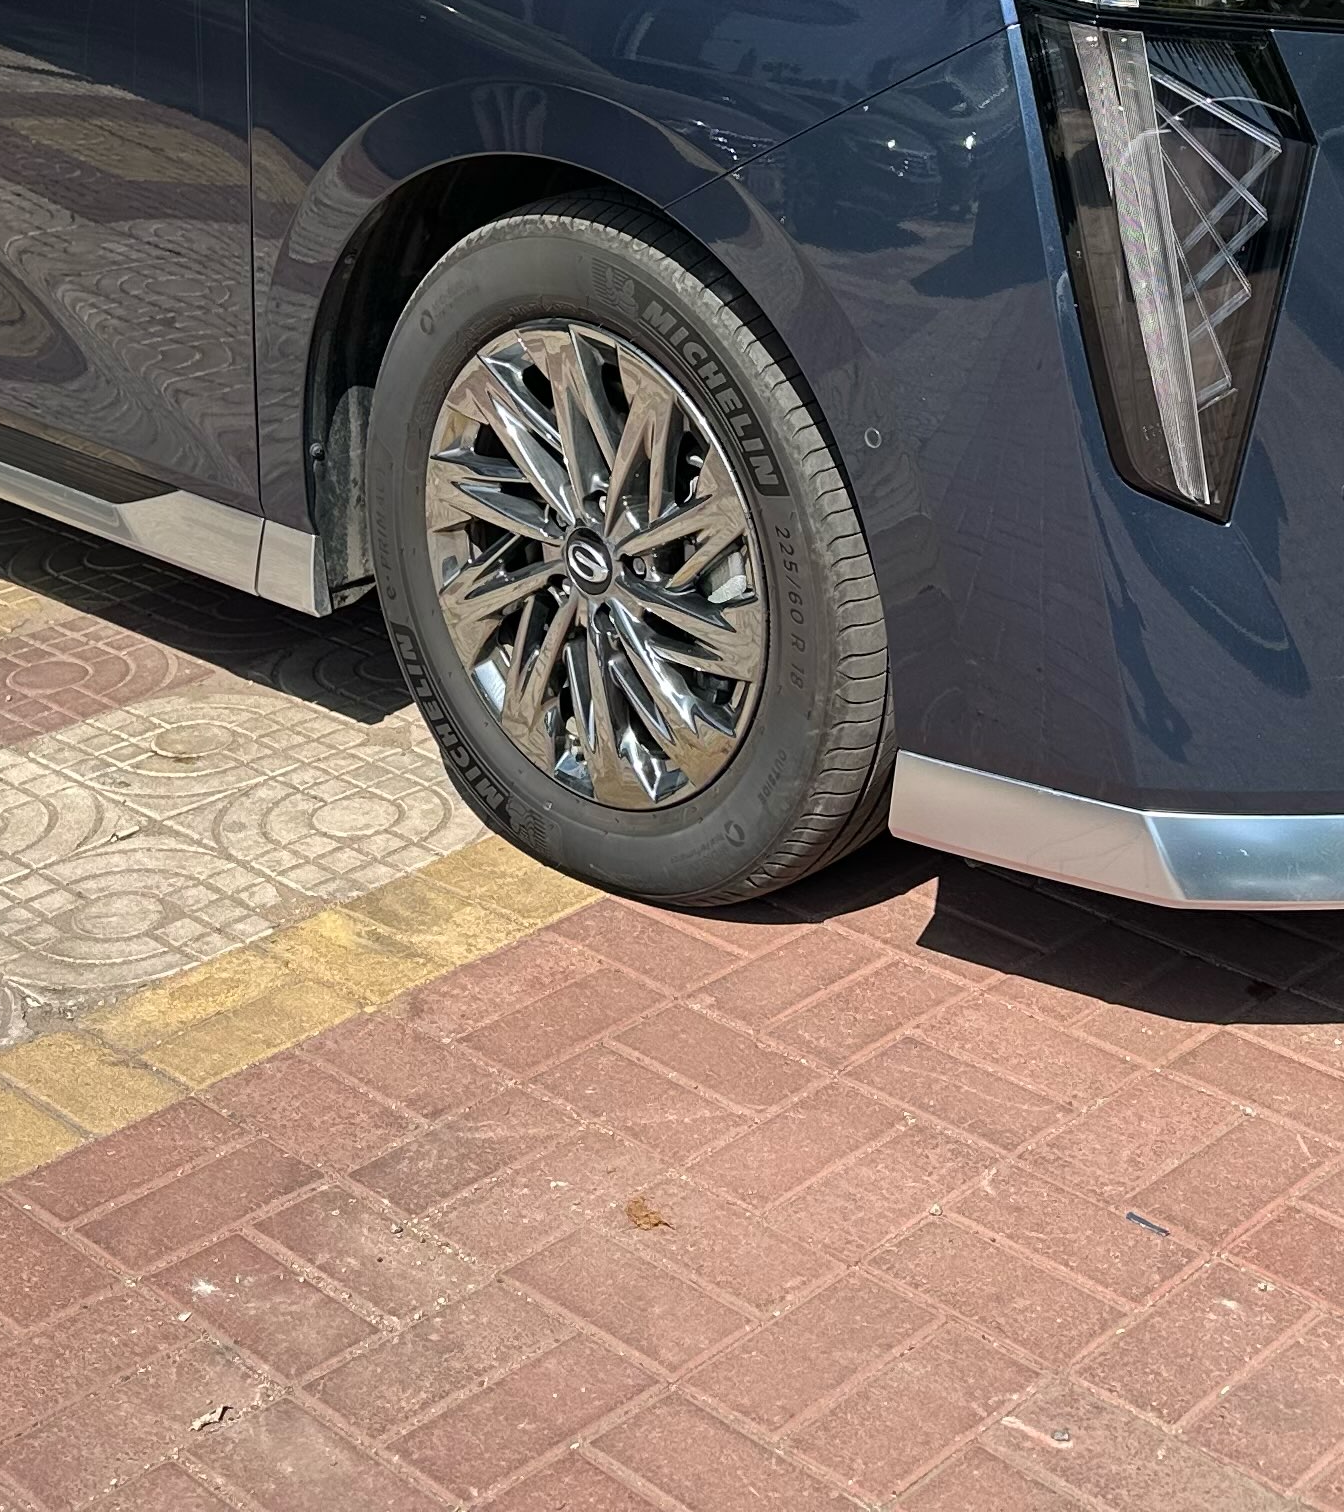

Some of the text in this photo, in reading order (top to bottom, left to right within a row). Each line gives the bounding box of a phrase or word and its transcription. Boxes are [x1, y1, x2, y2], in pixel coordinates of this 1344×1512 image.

[641, 299, 780, 488] MICHELIN
[775, 525, 806, 691] 225/60 R 18
[395, 632, 507, 811] MICHELIN
